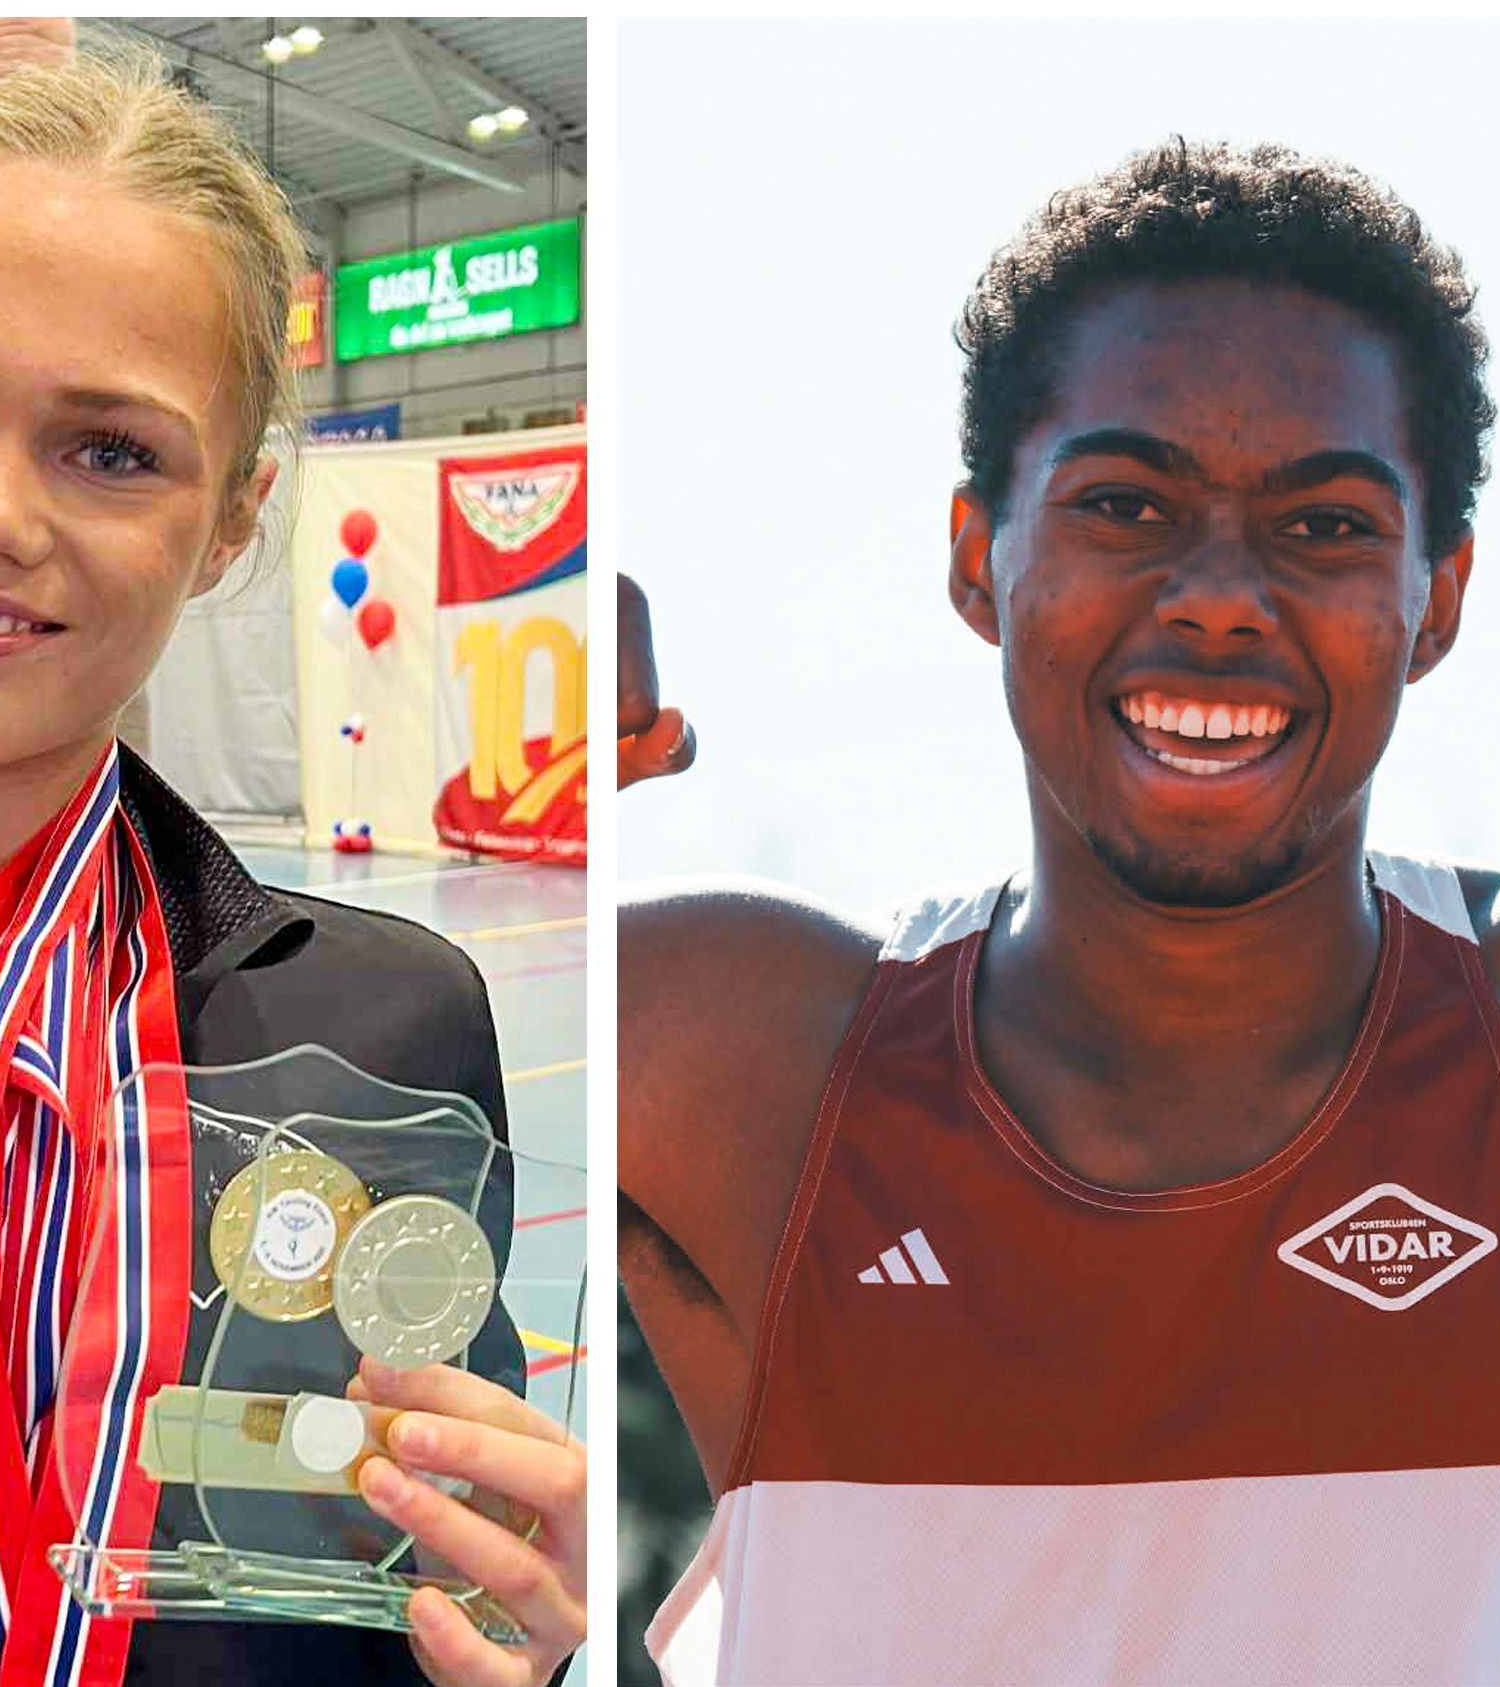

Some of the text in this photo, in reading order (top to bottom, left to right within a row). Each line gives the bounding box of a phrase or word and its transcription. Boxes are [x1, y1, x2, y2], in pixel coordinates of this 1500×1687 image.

[484, 479, 538, 499] FANA
[451, 615, 587, 800] 10
[1323, 1231, 1456, 1264] VIDAR
[1379, 1276, 1406, 1286] OSLO
